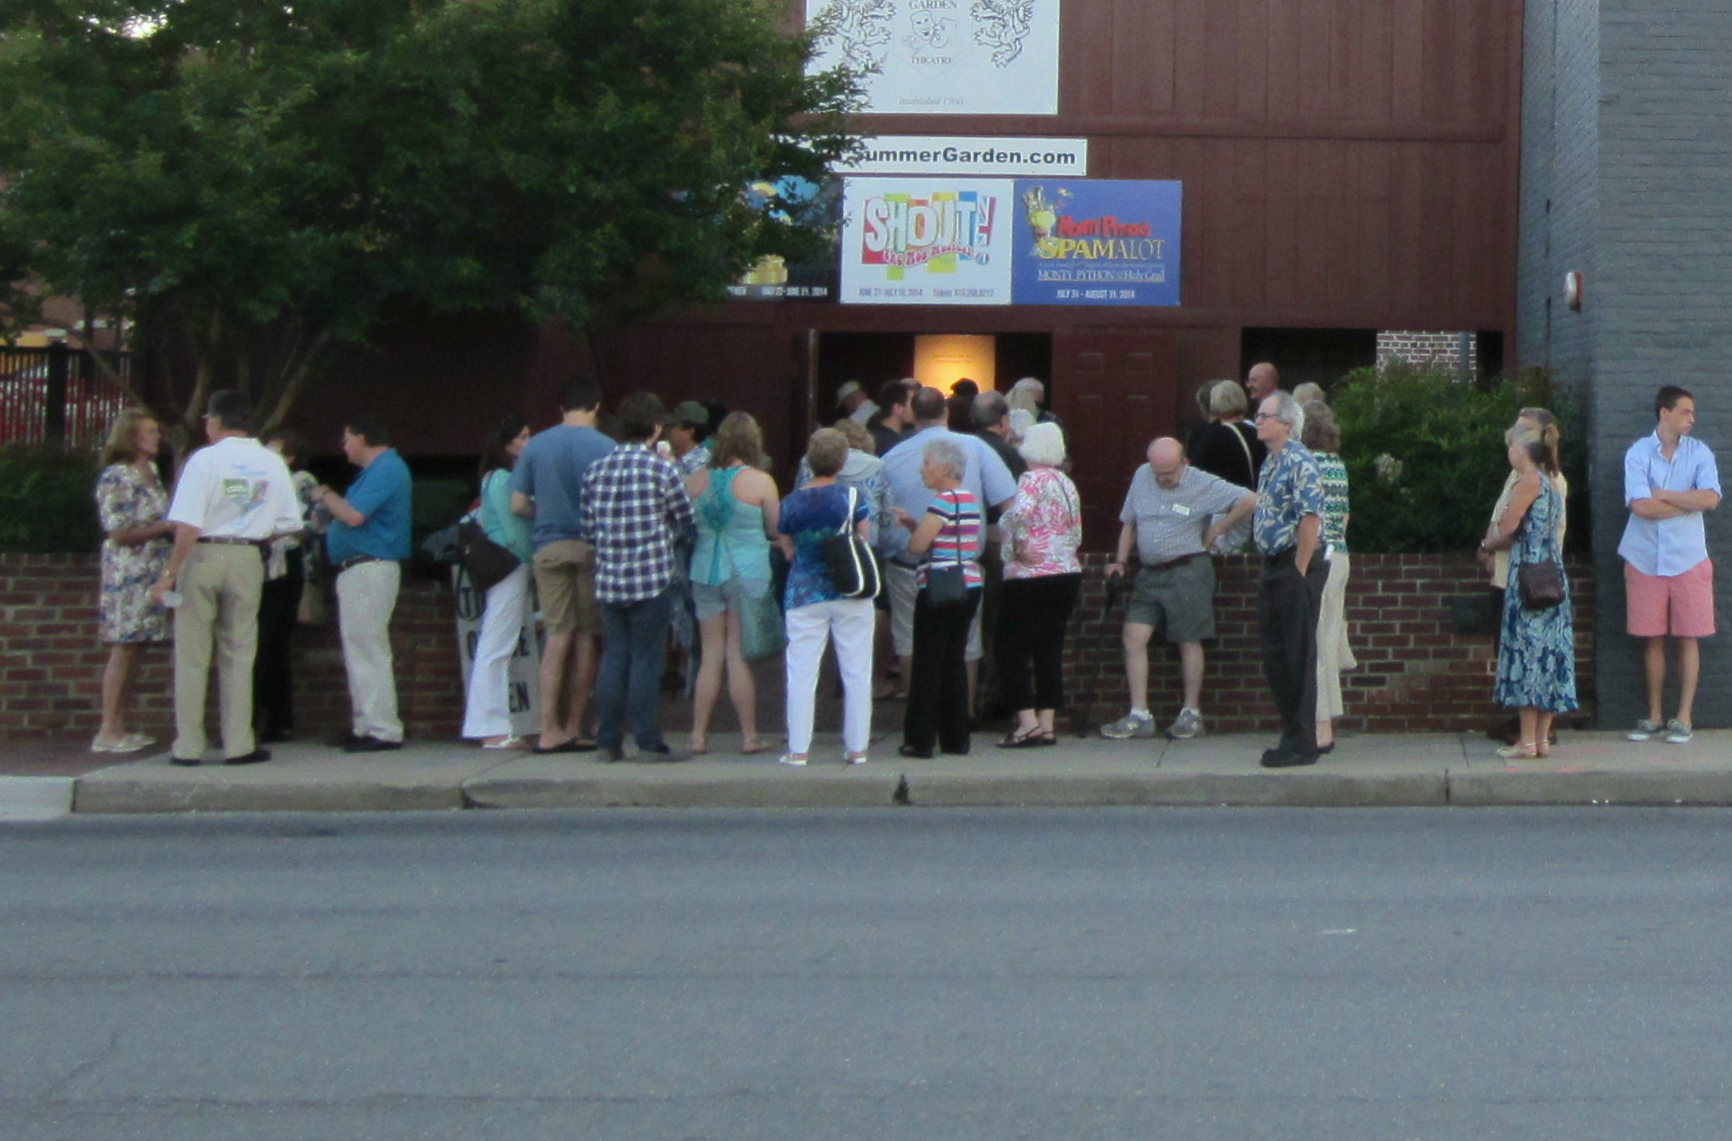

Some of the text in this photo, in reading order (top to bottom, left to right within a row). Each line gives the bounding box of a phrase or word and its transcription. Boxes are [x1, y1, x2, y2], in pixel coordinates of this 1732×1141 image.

[909, 0, 958, 9] GARDEN
[864, 196, 996, 265] SHOUT!
[1038, 237, 1165, 259] SPAMALOT
[1038, 269, 1072, 280] MONTY
[1076, 269, 1114, 280] PYTHON
